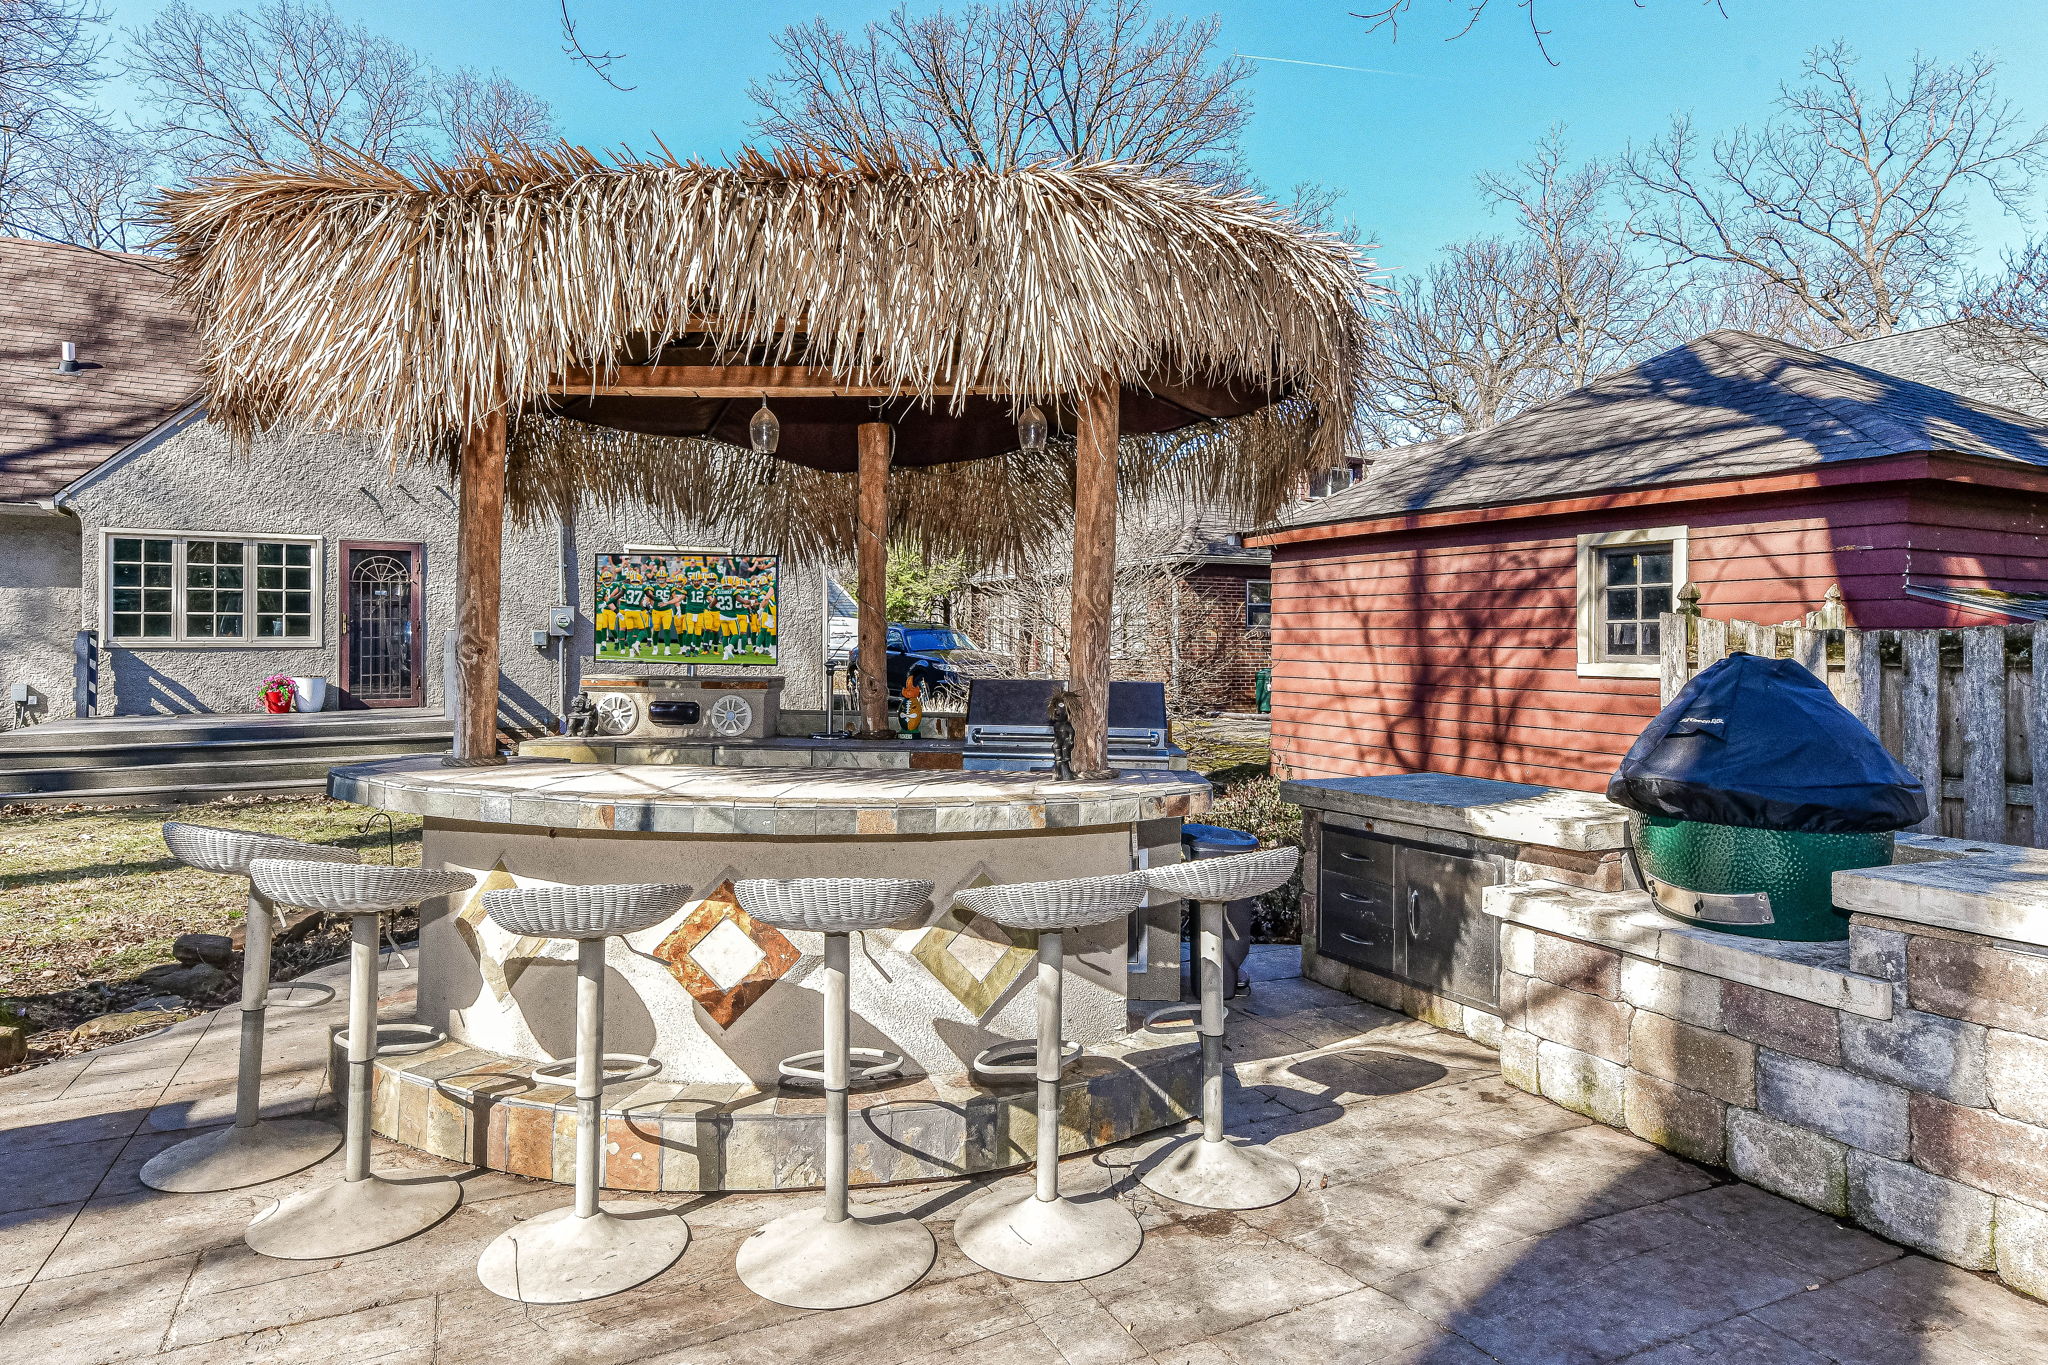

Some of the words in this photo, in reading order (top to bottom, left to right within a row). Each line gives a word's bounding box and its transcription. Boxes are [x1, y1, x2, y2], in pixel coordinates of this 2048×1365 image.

[626, 589, 643, 605] 37
[690, 590, 704, 603] 12
[717, 595, 733, 611] 23
